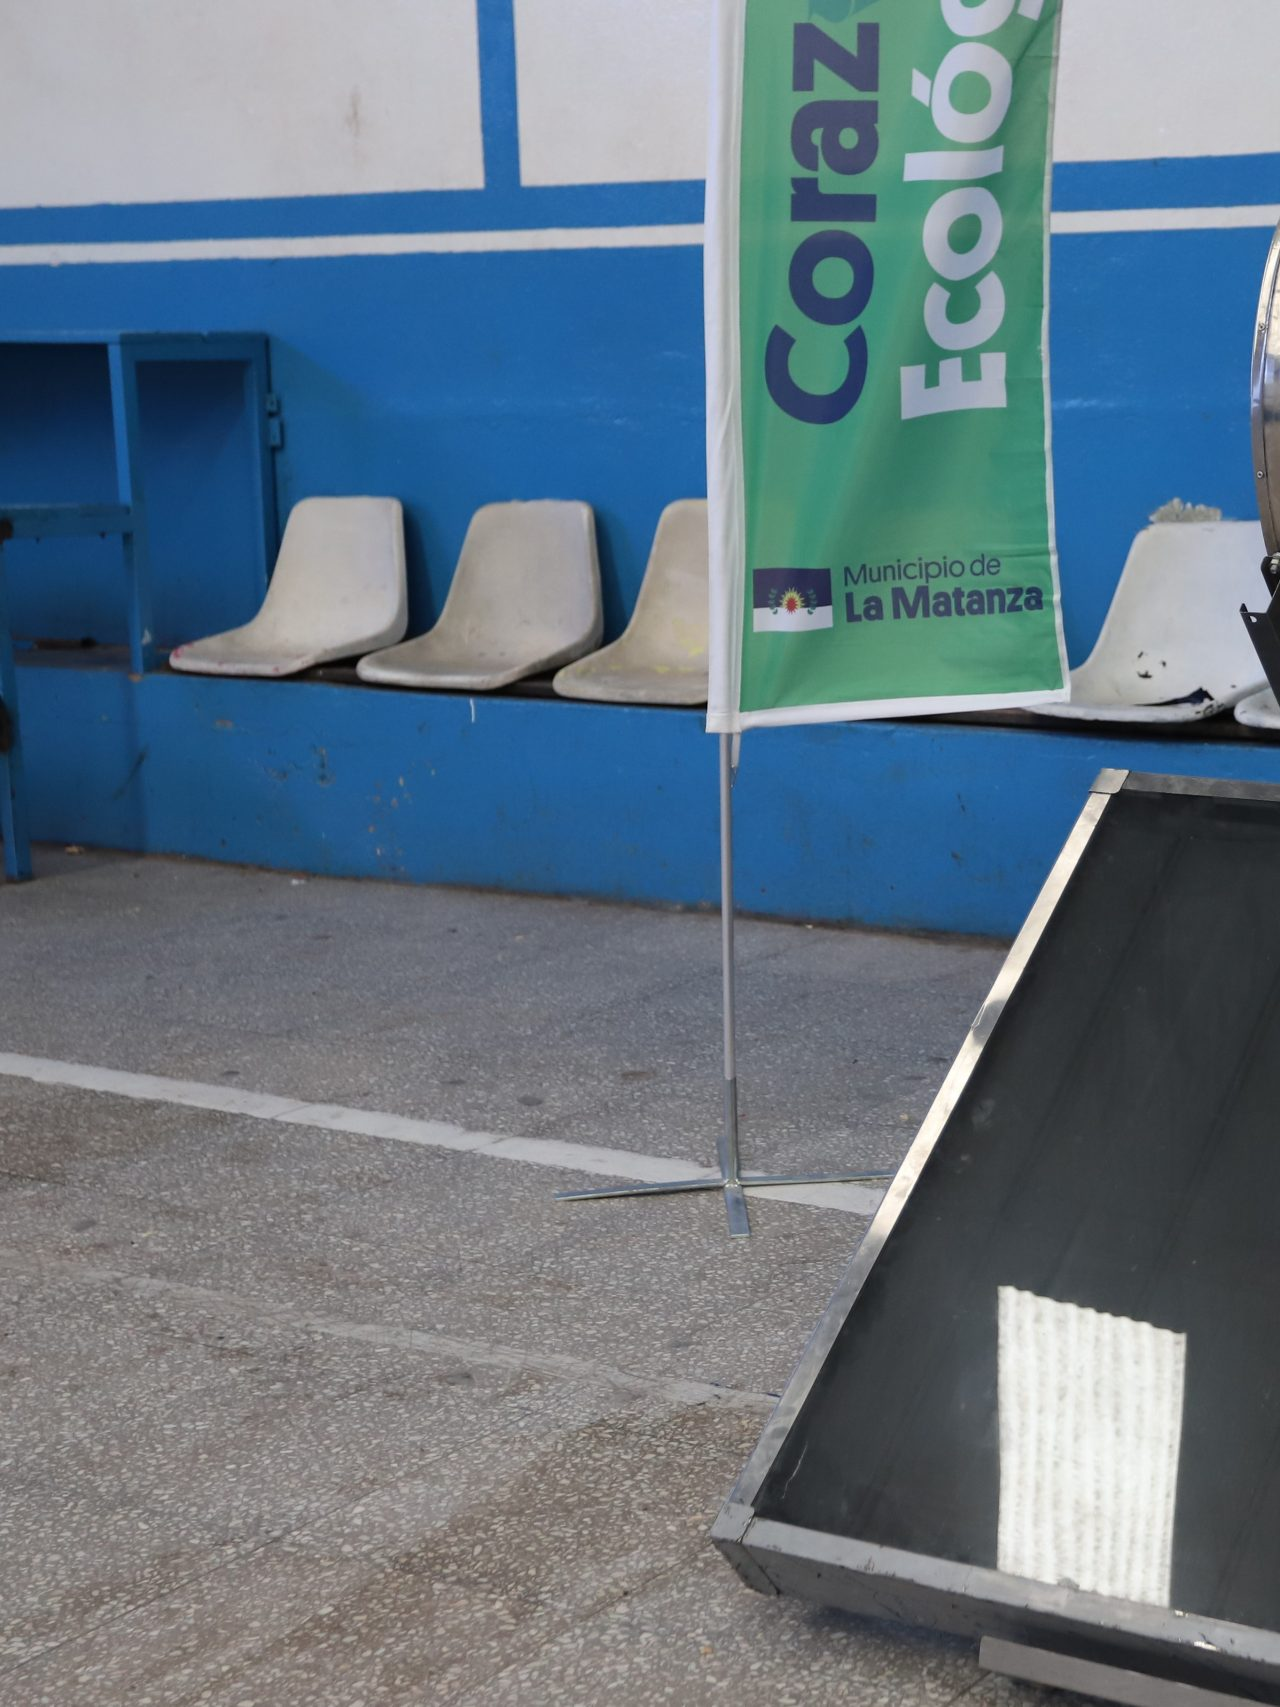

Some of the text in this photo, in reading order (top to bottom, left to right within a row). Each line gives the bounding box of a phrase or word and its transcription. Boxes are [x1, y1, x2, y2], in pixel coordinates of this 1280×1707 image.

[843, 554, 1001, 587] Municipio de
[845, 585, 1044, 623] La Matanza
